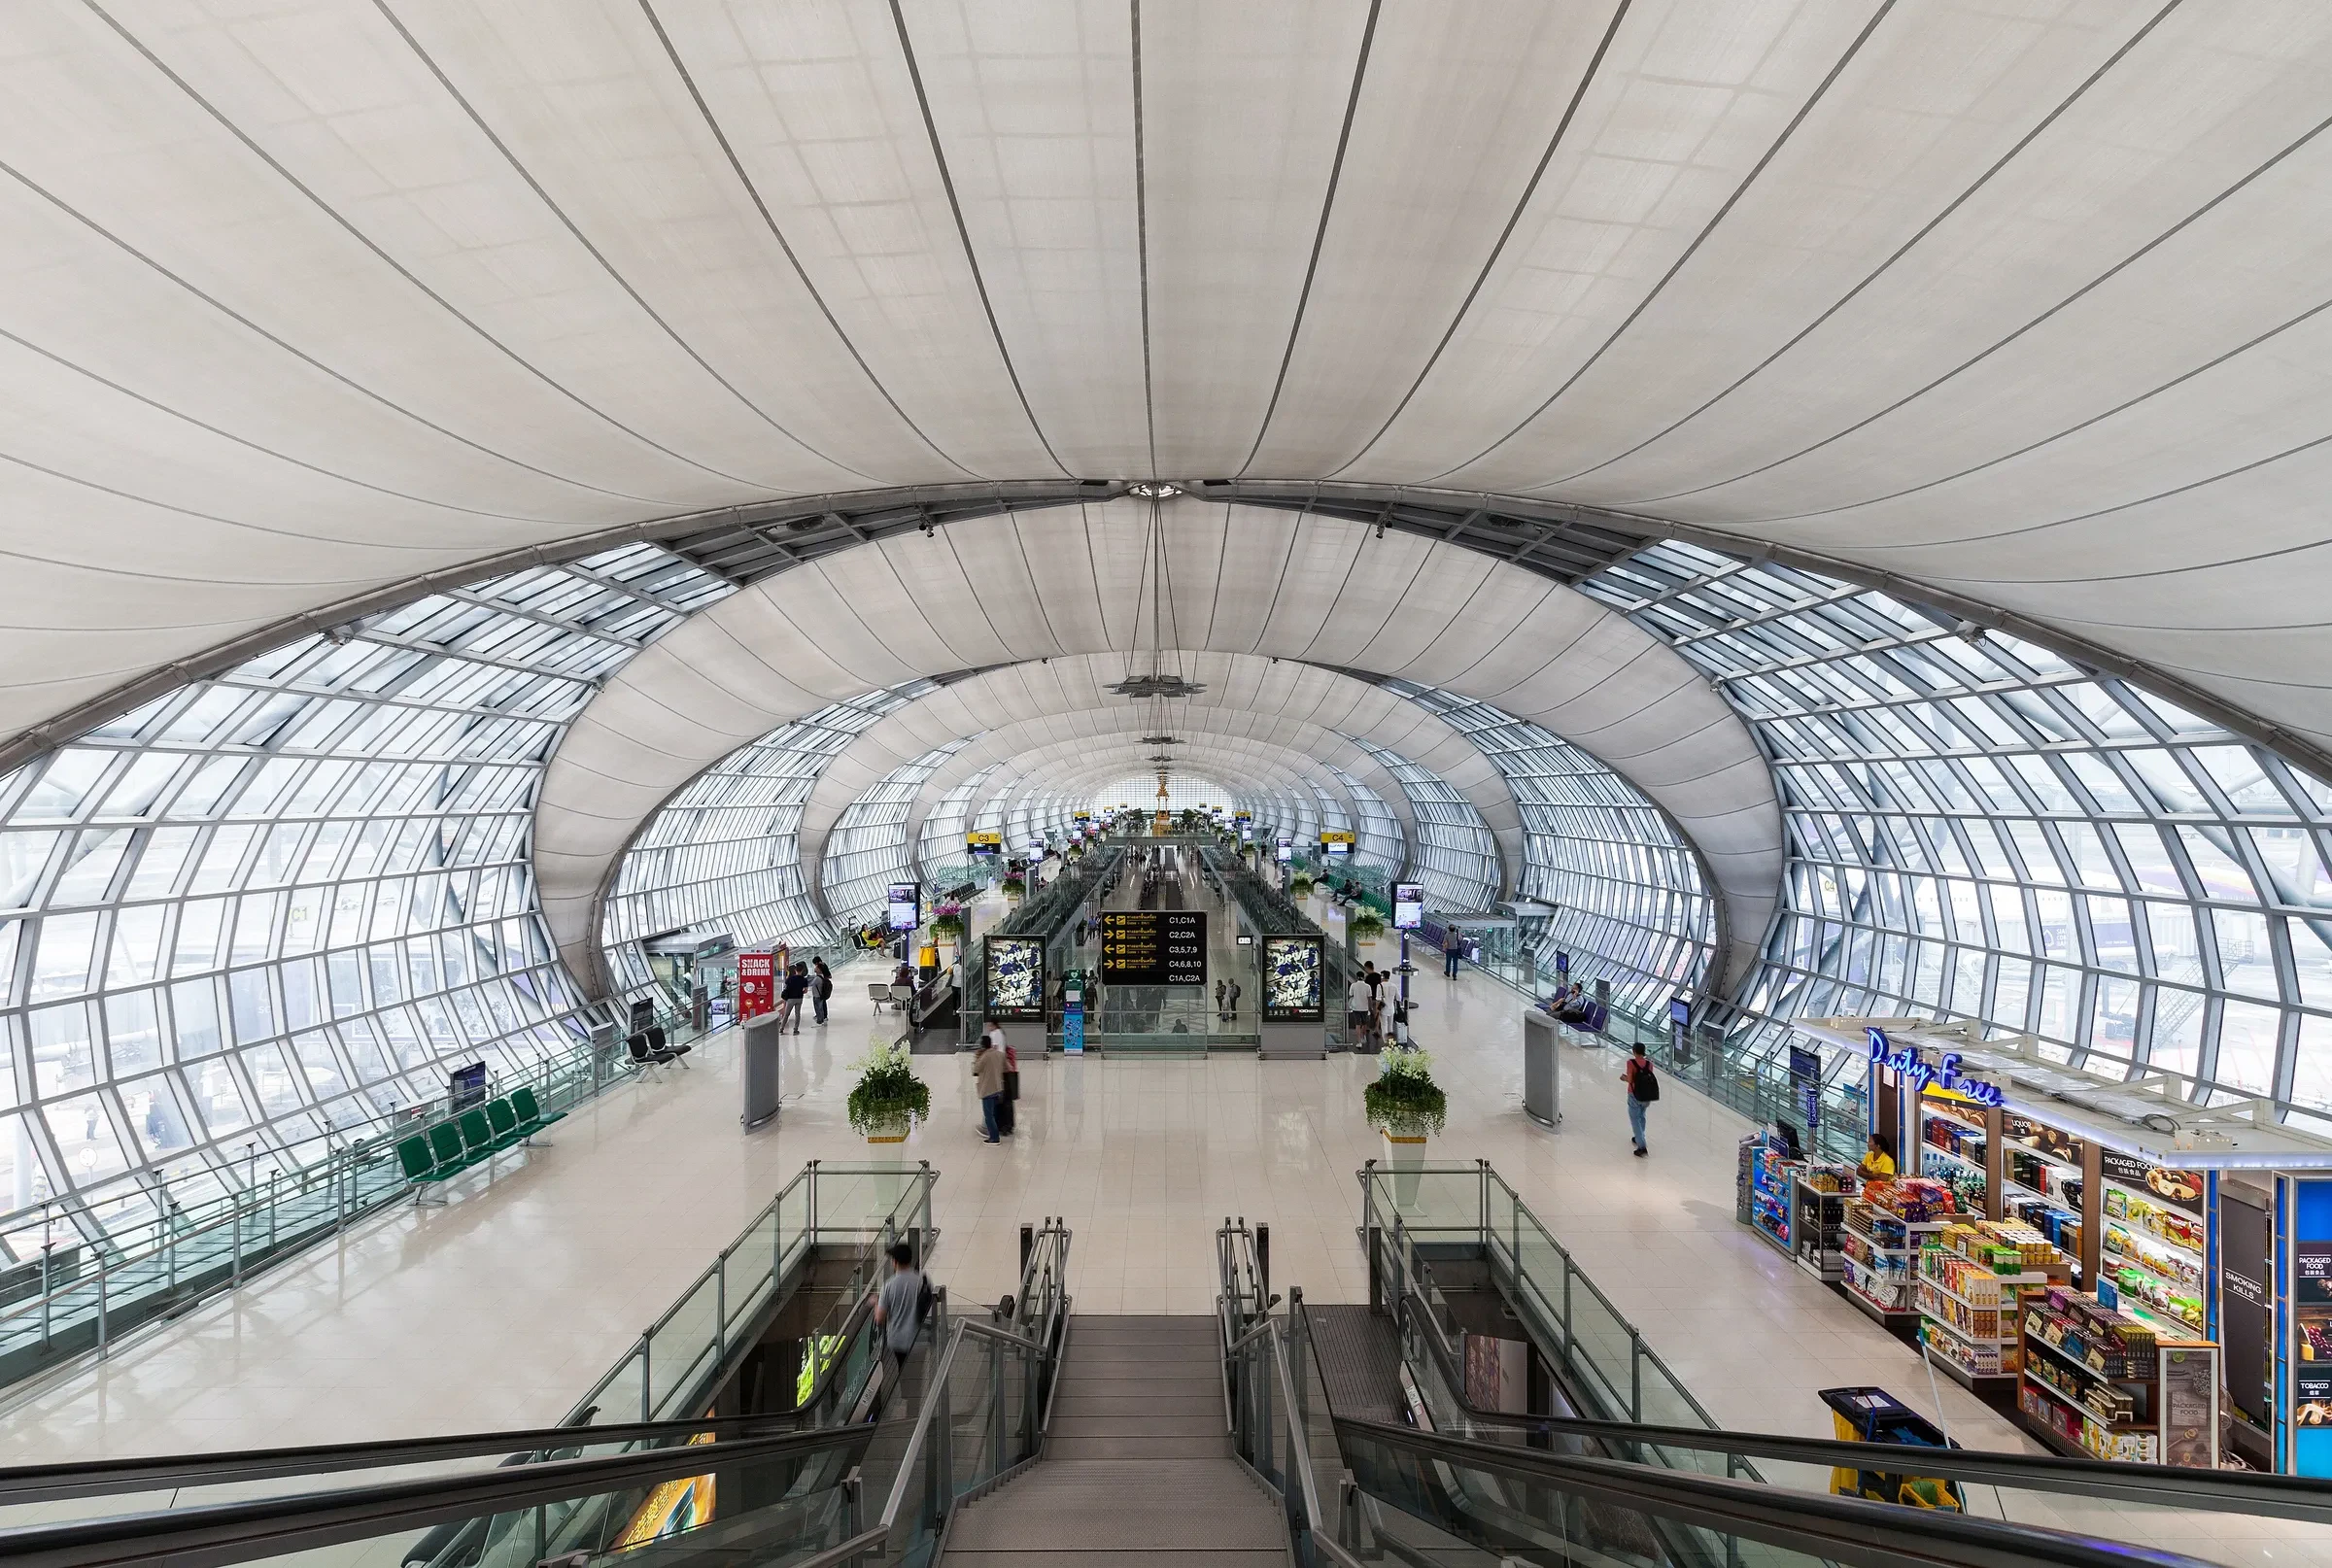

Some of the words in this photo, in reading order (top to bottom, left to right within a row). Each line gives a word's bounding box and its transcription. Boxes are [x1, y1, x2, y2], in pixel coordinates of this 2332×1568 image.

[1825, 880, 1835, 891] C4
[292, 907, 307, 921] C1
[741, 959, 770, 968] SNACK
[999, 986, 1031, 1002] MORE
[1278, 987, 1309, 1002] MORE
[1869, 1027, 1935, 1091] Duty
[1939, 1053, 2004, 1107] Free
[2011, 1119, 2032, 1129] LIQUOR
[2105, 1156, 2136, 1168] PACKAGED
[2225, 1272, 2262, 1294] SMOKING
[2233, 1283, 2254, 1299] KILLS
